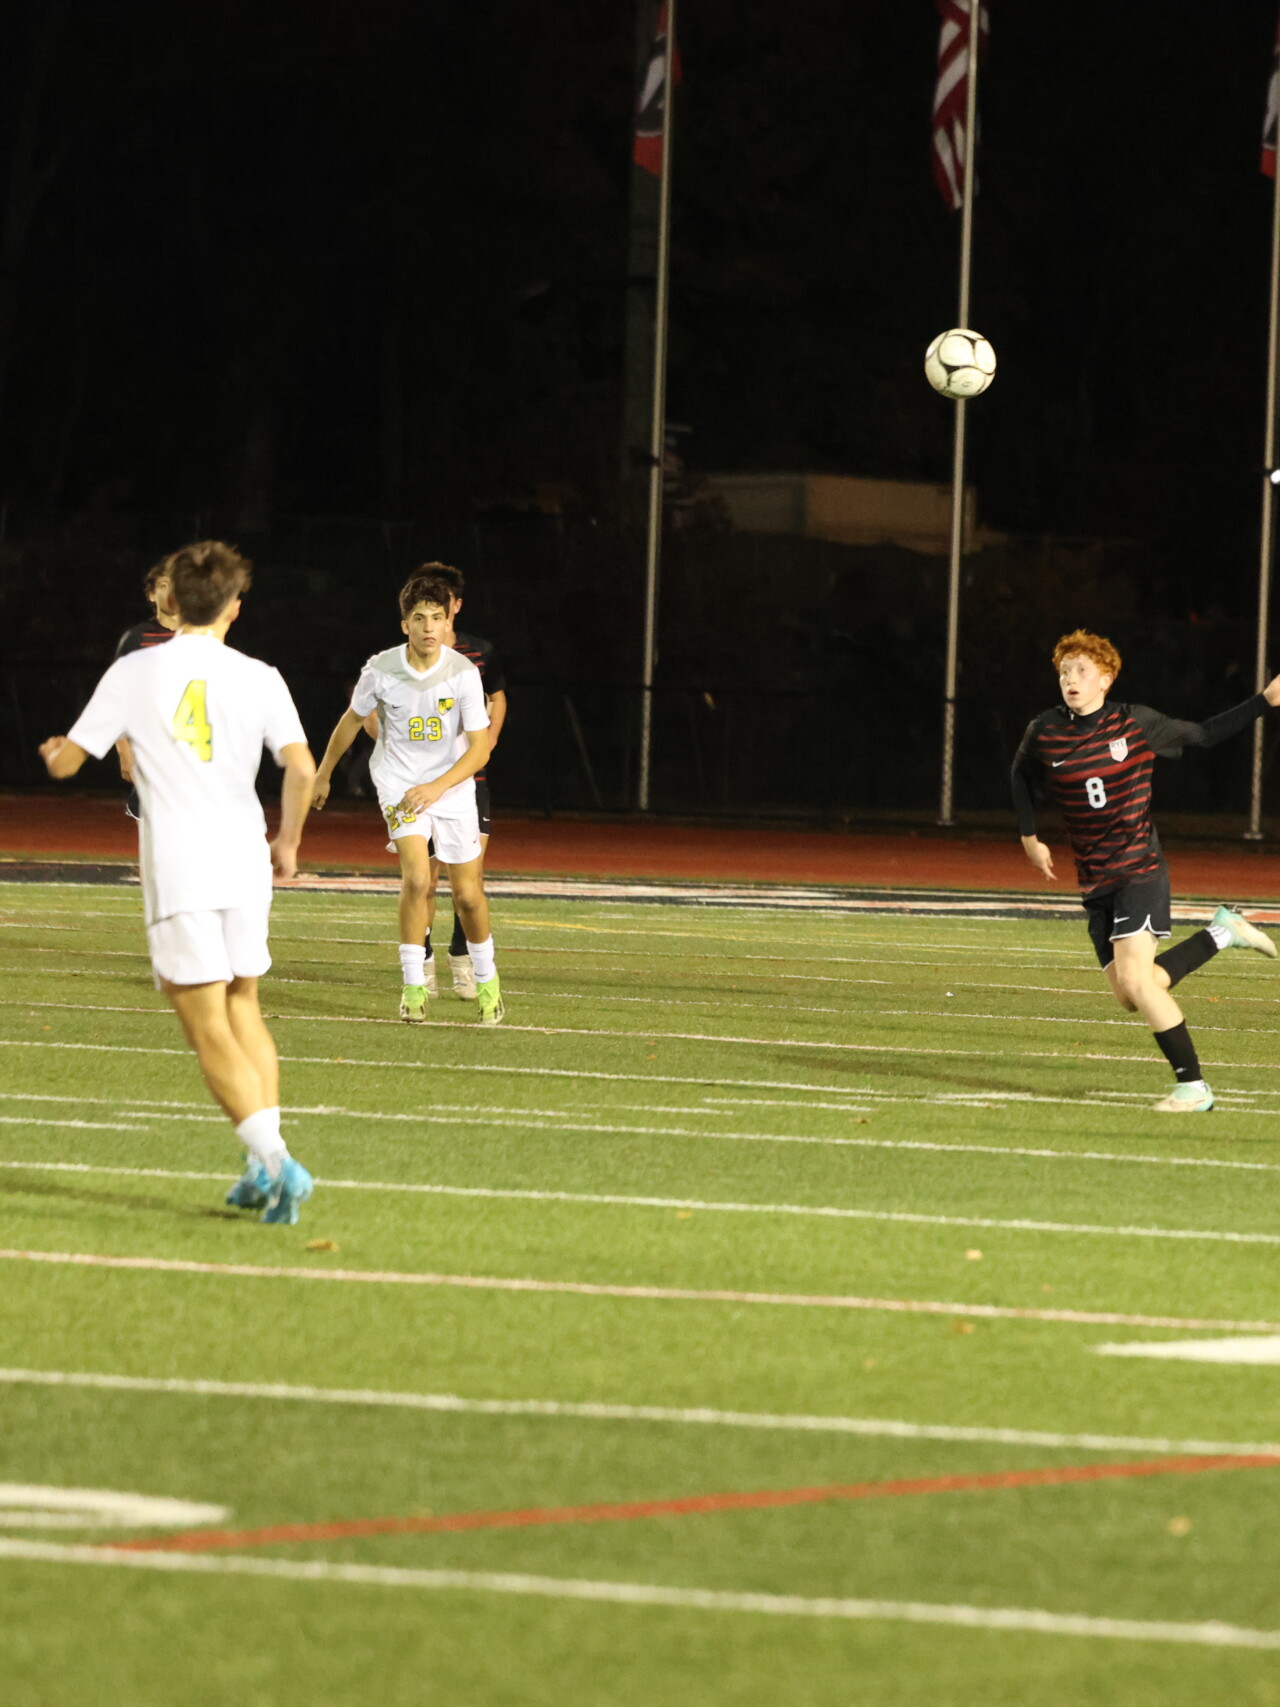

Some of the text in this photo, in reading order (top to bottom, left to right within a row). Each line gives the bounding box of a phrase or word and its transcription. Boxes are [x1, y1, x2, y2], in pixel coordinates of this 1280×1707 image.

[172, 679, 212, 762] 4
[408, 716, 443, 741] 23
[1085, 776, 1107, 809] 8
